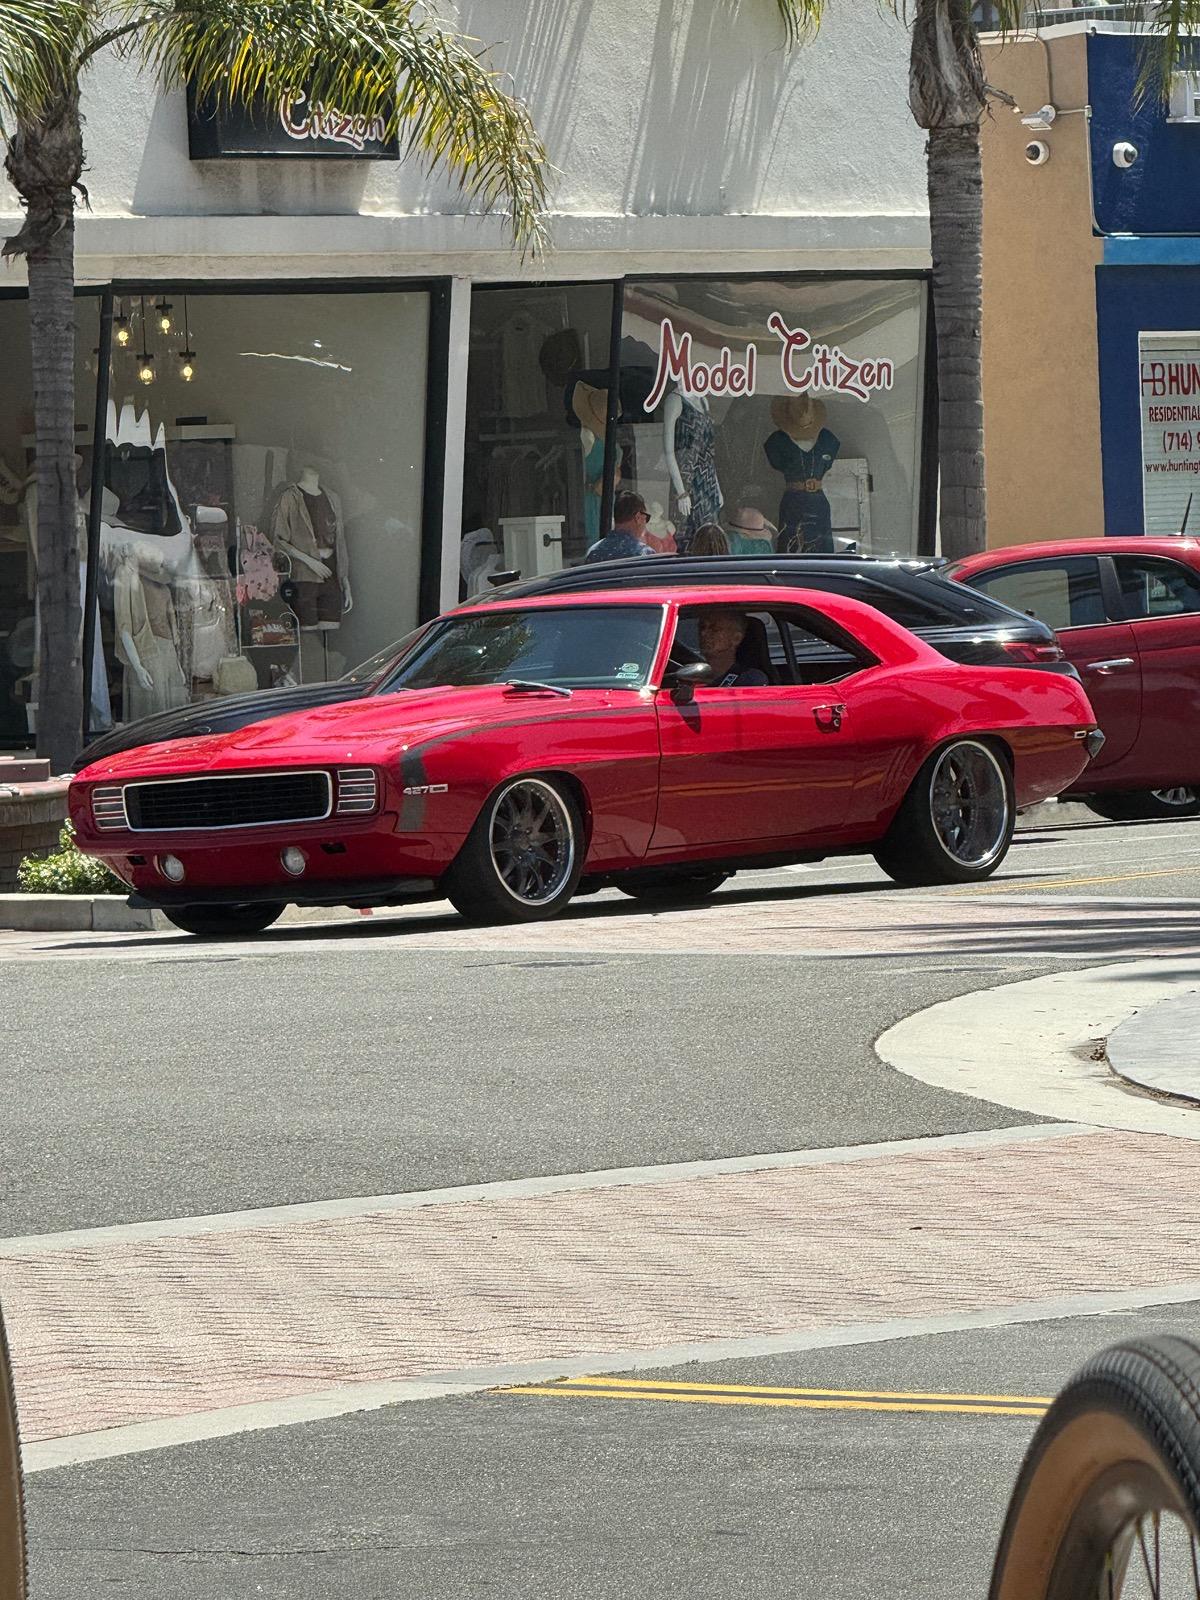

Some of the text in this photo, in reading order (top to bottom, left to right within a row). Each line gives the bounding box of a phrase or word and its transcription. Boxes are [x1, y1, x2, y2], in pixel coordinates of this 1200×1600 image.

[643, 312, 895, 413] Model Citizen
[1163, 429, 1193, 453] (714)
[403, 785, 429, 795] 427
